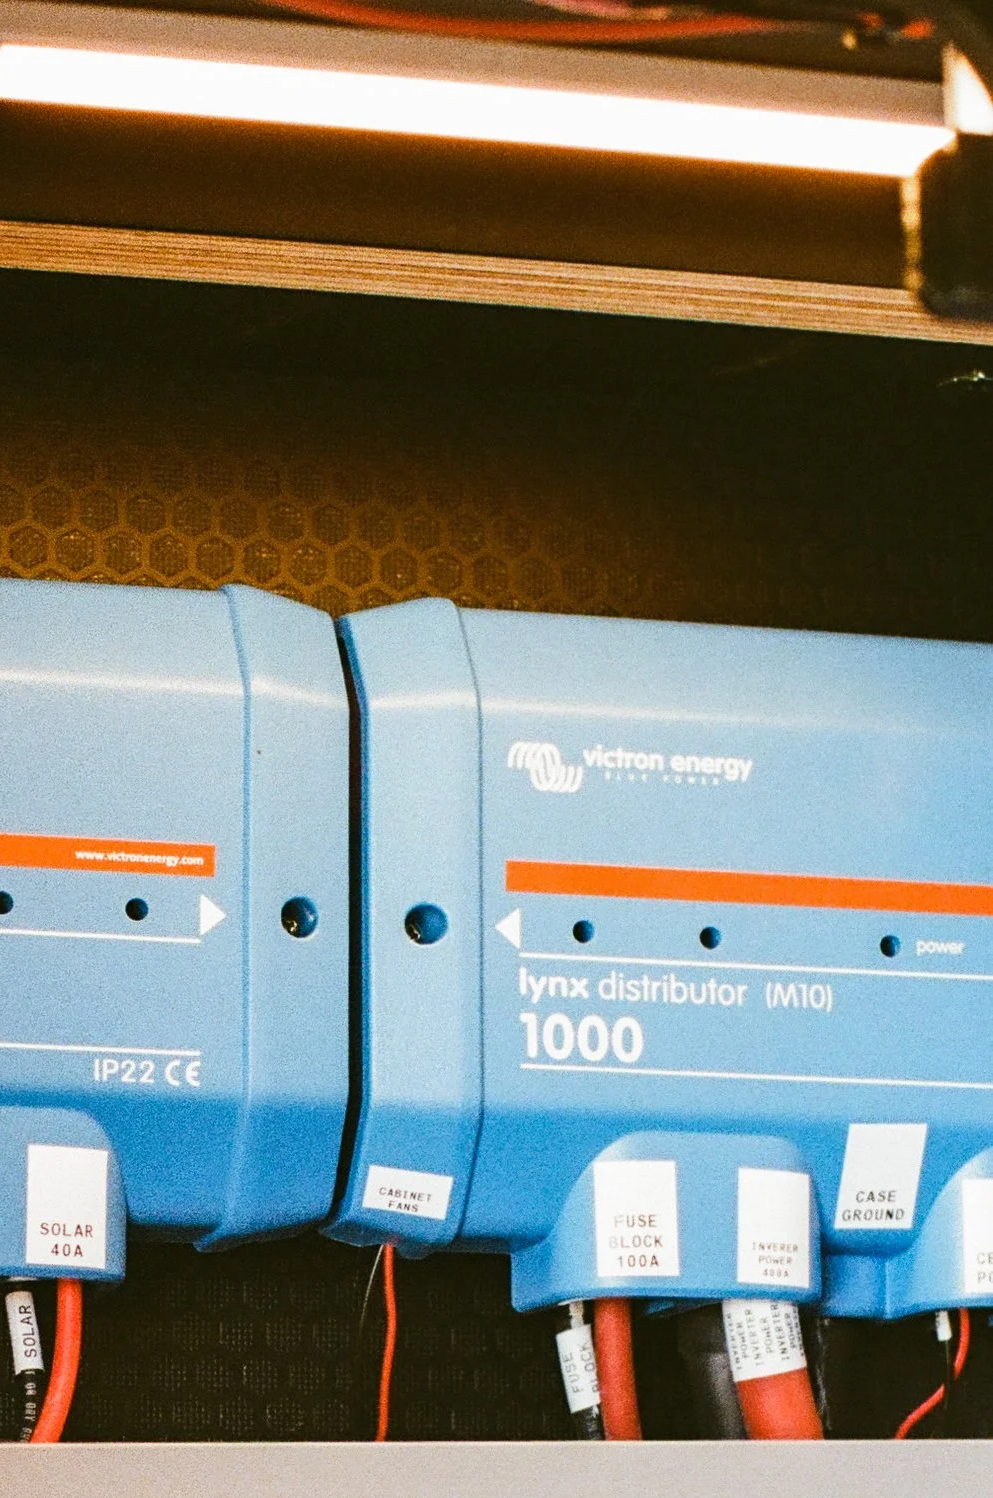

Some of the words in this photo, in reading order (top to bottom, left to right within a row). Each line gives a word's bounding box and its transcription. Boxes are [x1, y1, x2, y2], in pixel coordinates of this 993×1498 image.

[582, 744, 664, 771] victron
[670, 755, 754, 783] energy
[74, 850, 205, 868] www.victronenergy.com
[915, 939, 966, 957] power
[518, 966, 590, 1000] lynx
[598, 971, 748, 1006] distributor
[764, 982, 834, 1013] (M10)
[518, 1012, 644, 1064] 1000
[92, 1058, 155, 1084] IP22
[378, 1186, 433, 1202] CABINET
[855, 1190, 897, 1204] CASE
[388, 1200, 419, 1213] FANS
[613, 1214, 658, 1229] FUSE
[841, 1208, 906, 1222] GROUND
[39, 1222, 94, 1238] SOLAR
[608, 1234, 664, 1249] BLOCK
[50, 1243, 84, 1258] 40A
[617, 1254, 660, 1269] 100A
[758, 1255, 793, 1265] POWER
[18, 1304, 38, 1359] SOLAR
[561, 1351, 584, 1394] FUSE
